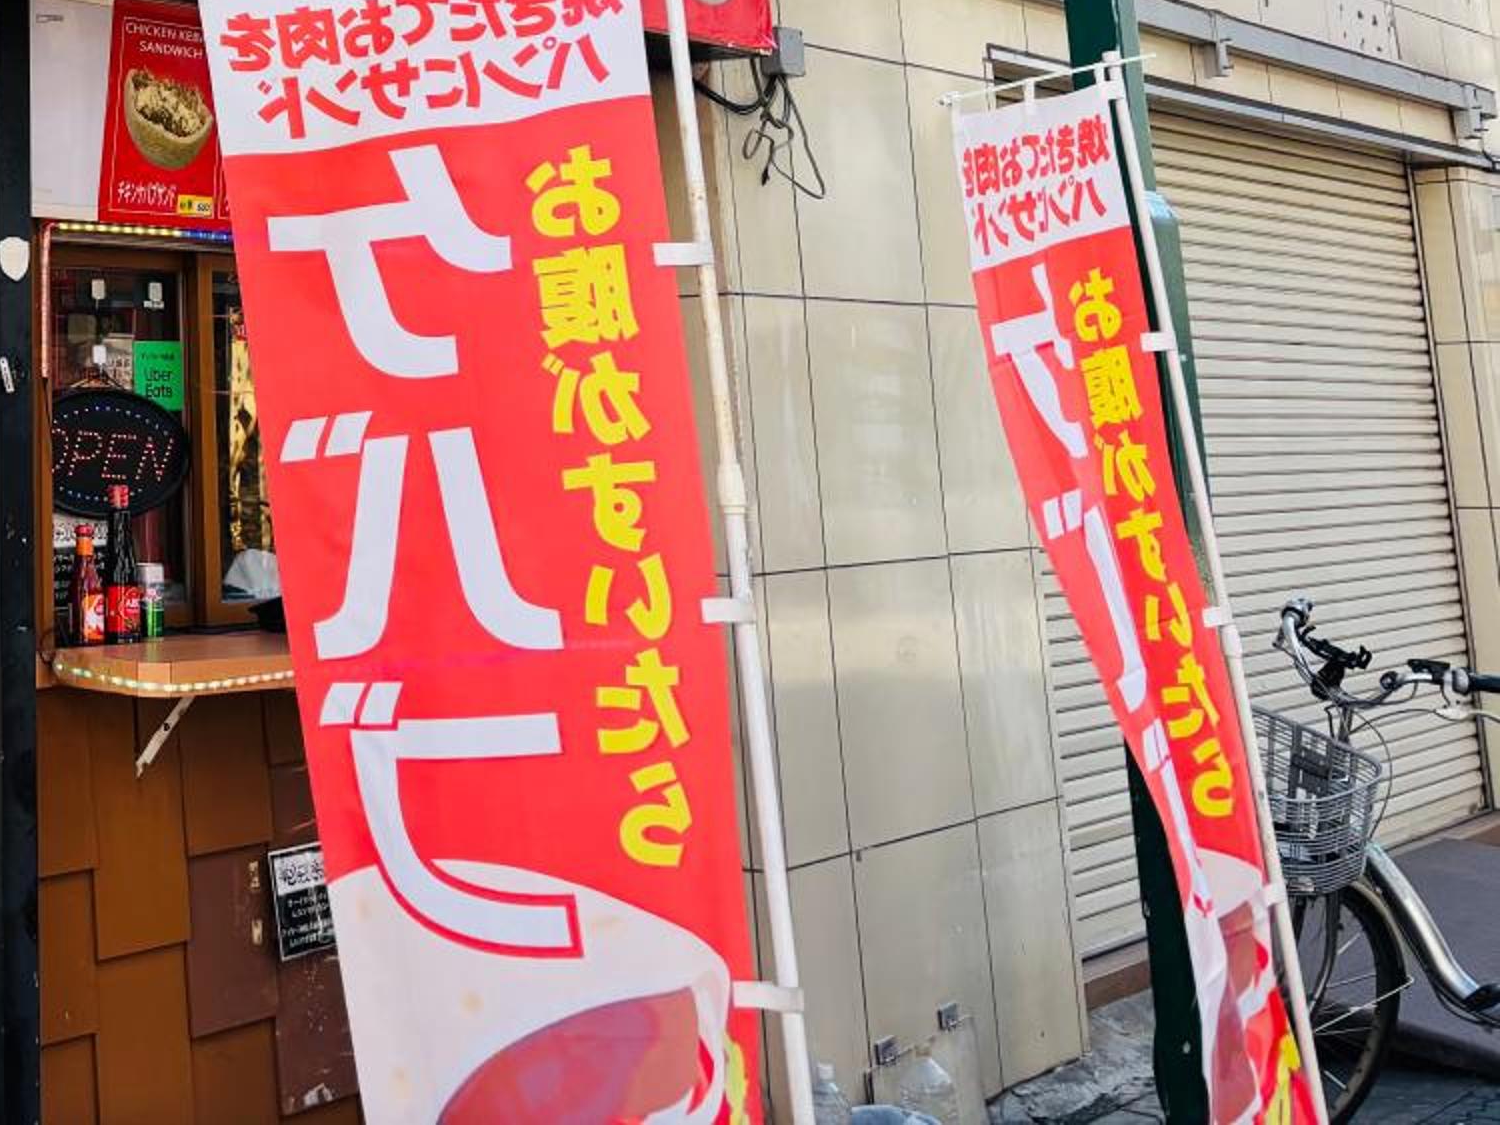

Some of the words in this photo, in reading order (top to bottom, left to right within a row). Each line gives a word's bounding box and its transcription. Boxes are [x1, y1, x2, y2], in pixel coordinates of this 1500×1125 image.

[125, 23, 177, 40] CHICKEN
[138, 41, 203, 60] SANDWICH
[144, 366, 172, 382] Uber
[145, 383, 173, 400] Eats
